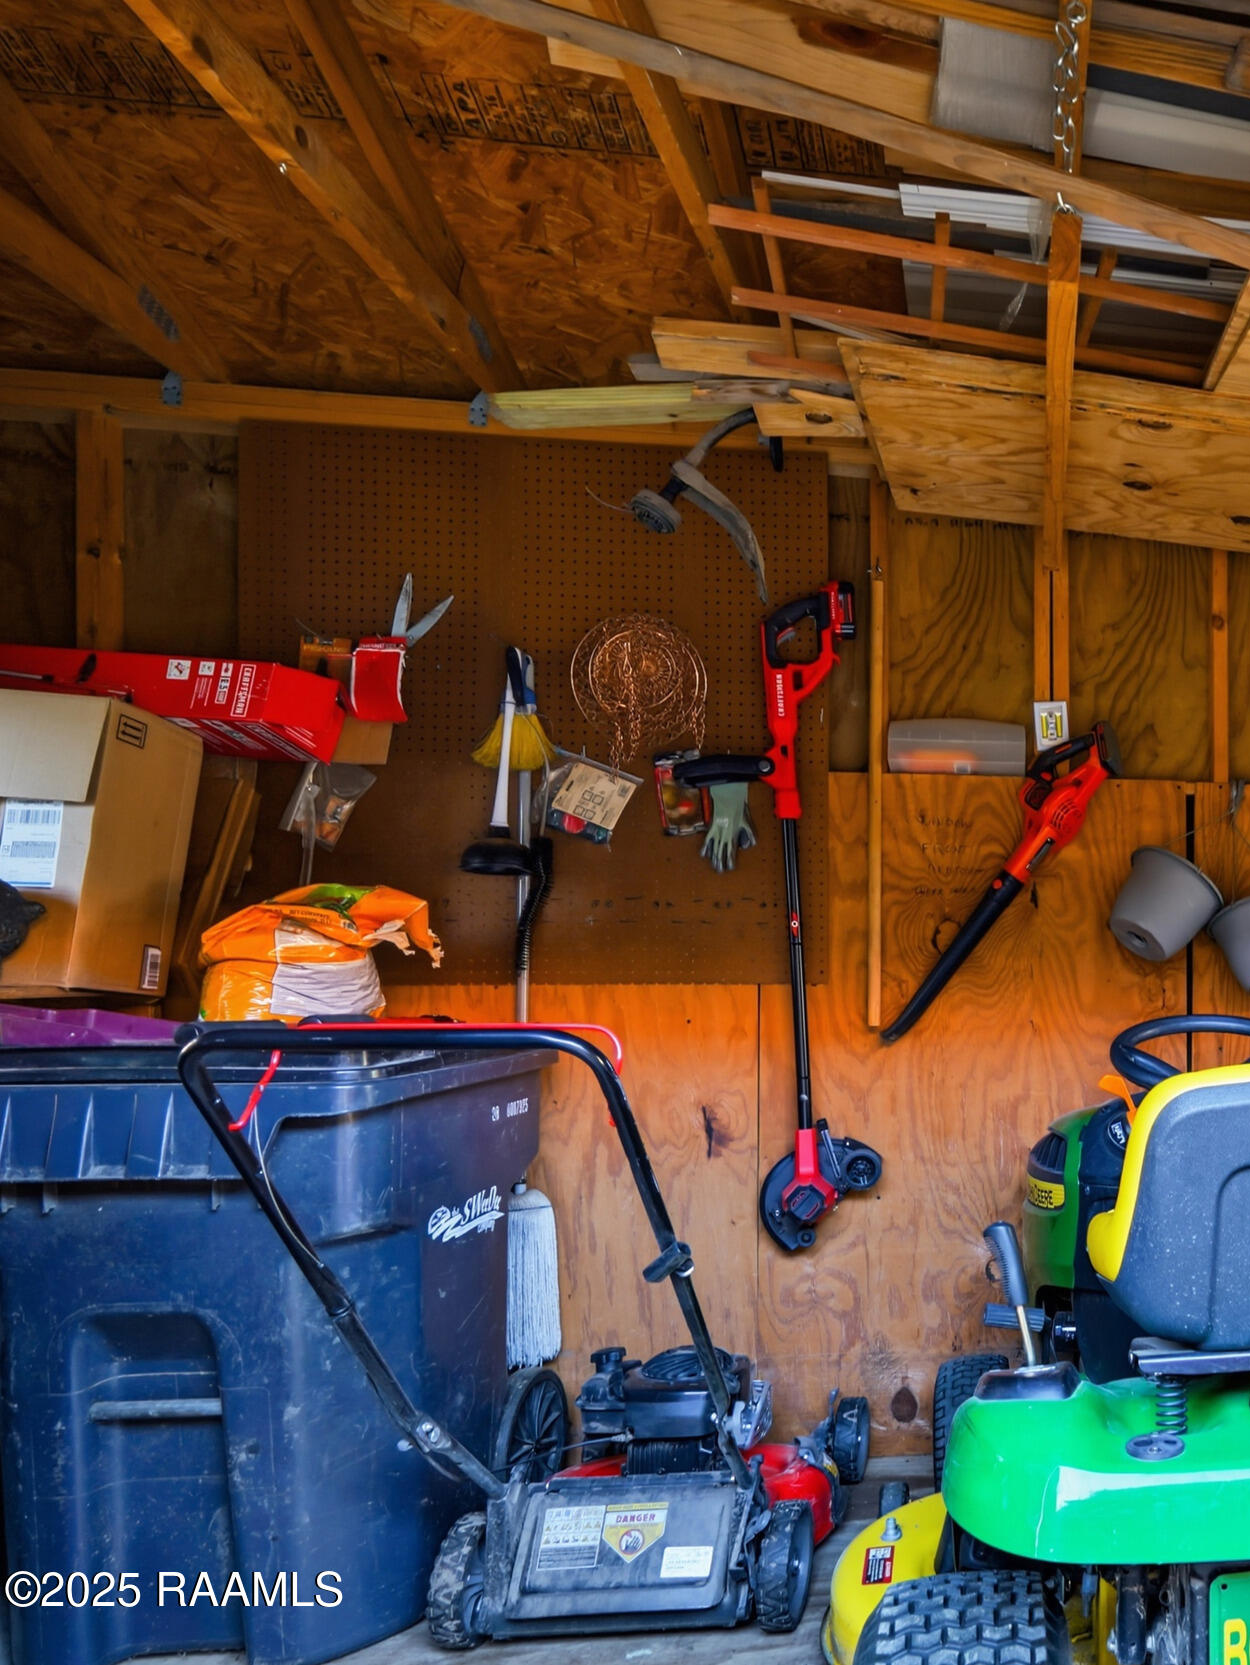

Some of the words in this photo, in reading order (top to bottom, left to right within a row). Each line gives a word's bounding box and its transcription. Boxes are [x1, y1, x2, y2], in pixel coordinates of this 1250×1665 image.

[234, 667, 252, 714] CRAFTSMAN
[776, 673, 785, 717] CRAFTSMAN
[616, 1513, 656, 1524] DANGER
